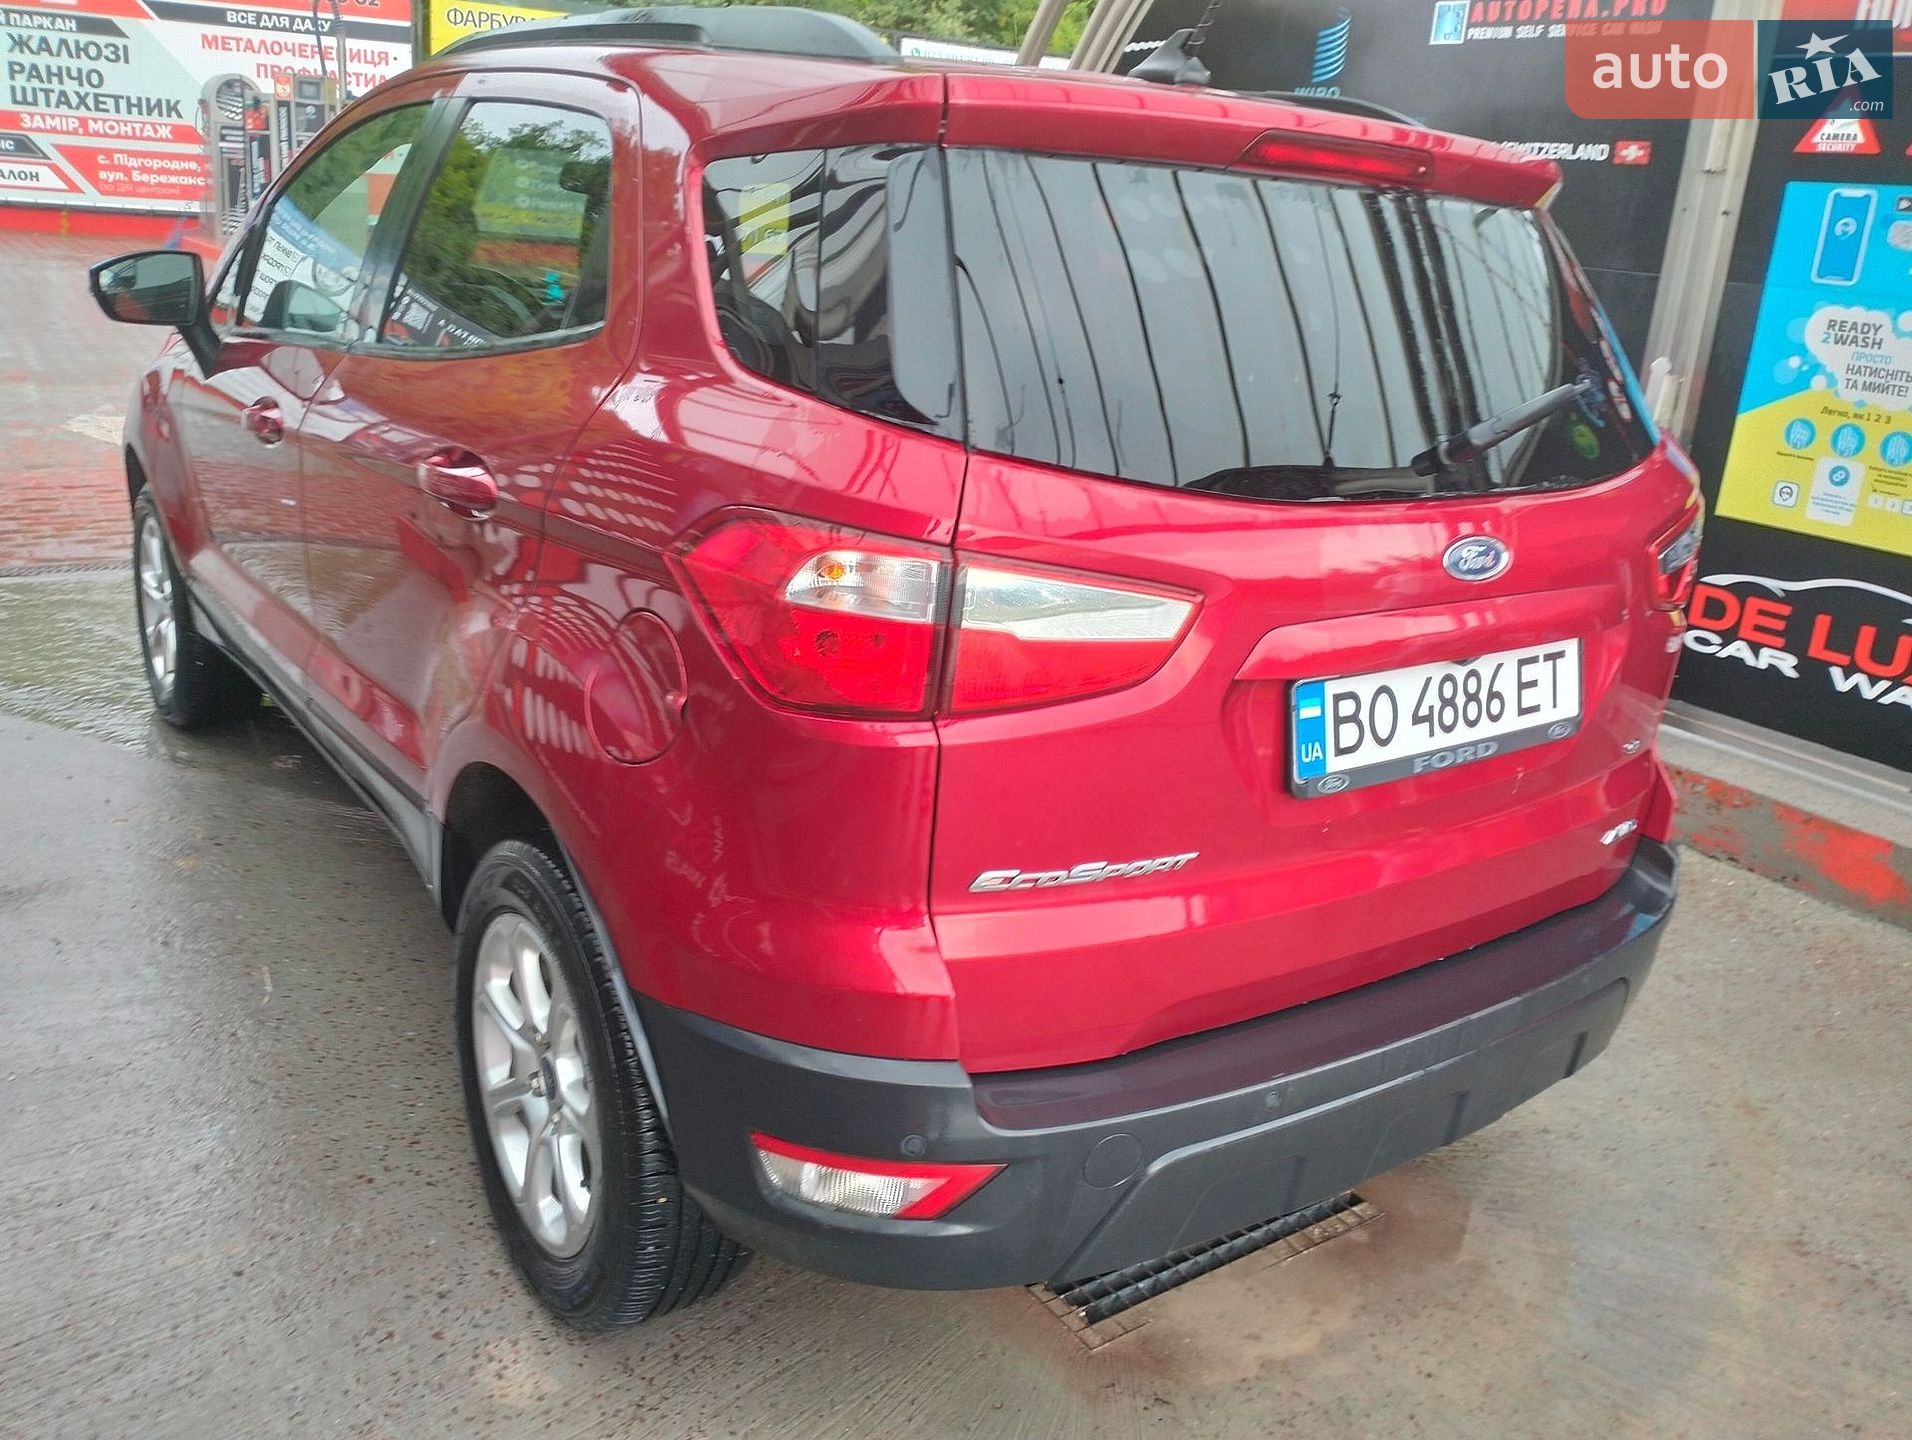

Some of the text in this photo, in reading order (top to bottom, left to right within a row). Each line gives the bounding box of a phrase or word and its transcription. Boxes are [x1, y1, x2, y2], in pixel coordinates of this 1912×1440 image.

[9, 12, 77, 32] ПАРКАН
[226, 10, 257, 25] ВСЕ
[259, 14, 290, 29] ДЛЯ
[447, 8, 536, 29] ФАРБУ
[6, 32, 130, 65] ЖАЛЮЗІ
[201, 33, 389, 67] МЕТАЛОЧЕРЕИЦЯ
[7, 60, 105, 89] РАНЧО
[256, 62, 388, 88] ПРОФАСТИЛ
[9, 85, 184, 119] ШТАХЕТНИК
[20, 113, 173, 140] ЗАМІР, МОНТАЖ
[1820, 132, 1858, 141] CAMERA
[97, 153, 201, 172] с. Підгородне,
[98, 170, 128, 183] вул.
[1826, 318, 1884, 336] READY
[1850, 351, 1893, 365] ПРОСТО
[1845, 363, 1912, 383] НАТИСНІТЬ
[1845, 378, 1910, 398] ТА МИЙТЕ!
[1874, 414, 1882, 423] 2
[1884, 415, 1892, 425] 3
[1687, 583, 1912, 685] DE LU
[1683, 628, 1801, 679] CAR
[1332, 649, 1567, 758] BO 4886 ET
[1301, 742, 1324, 764] UA
[1412, 740, 1499, 774] FORD
